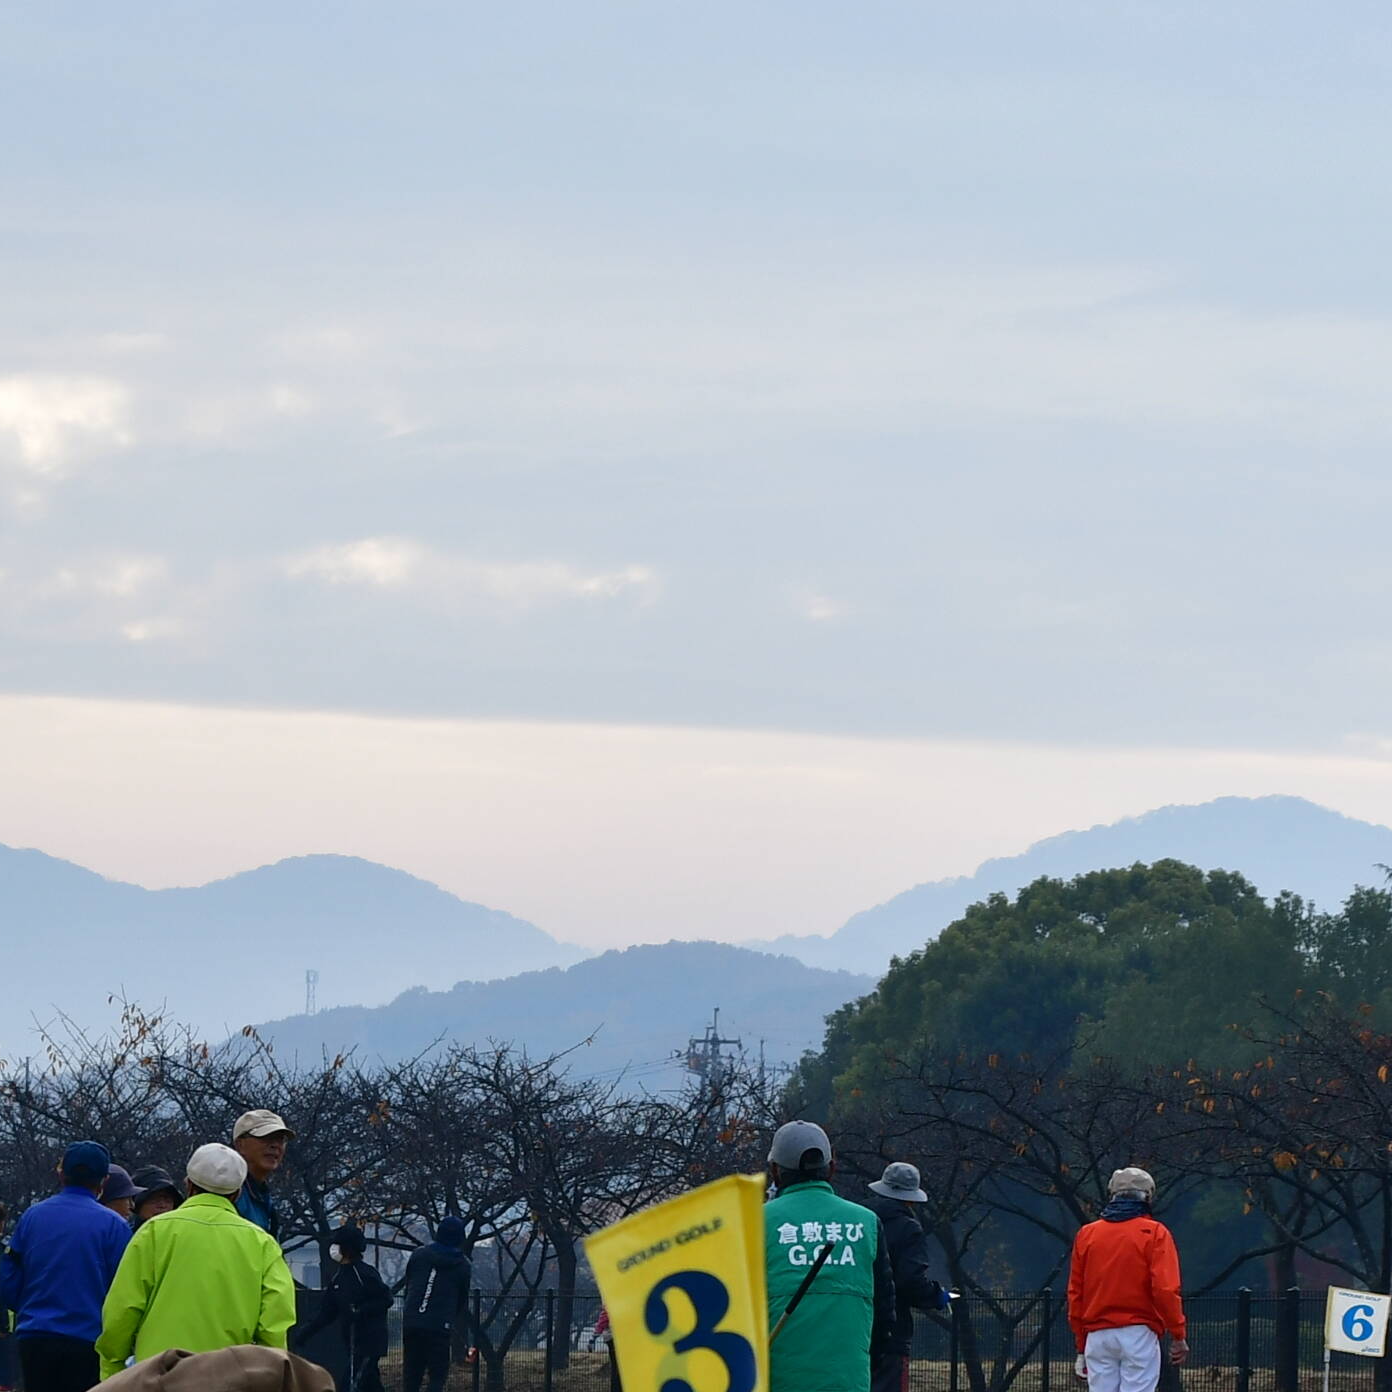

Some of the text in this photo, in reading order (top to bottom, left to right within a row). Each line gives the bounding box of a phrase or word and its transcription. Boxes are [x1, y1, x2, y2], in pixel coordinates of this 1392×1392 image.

[675, 1216, 722, 1245] GOLF
[777, 1221, 864, 1244] 倉敷まび
[1341, 1304, 1374, 1342] 6
